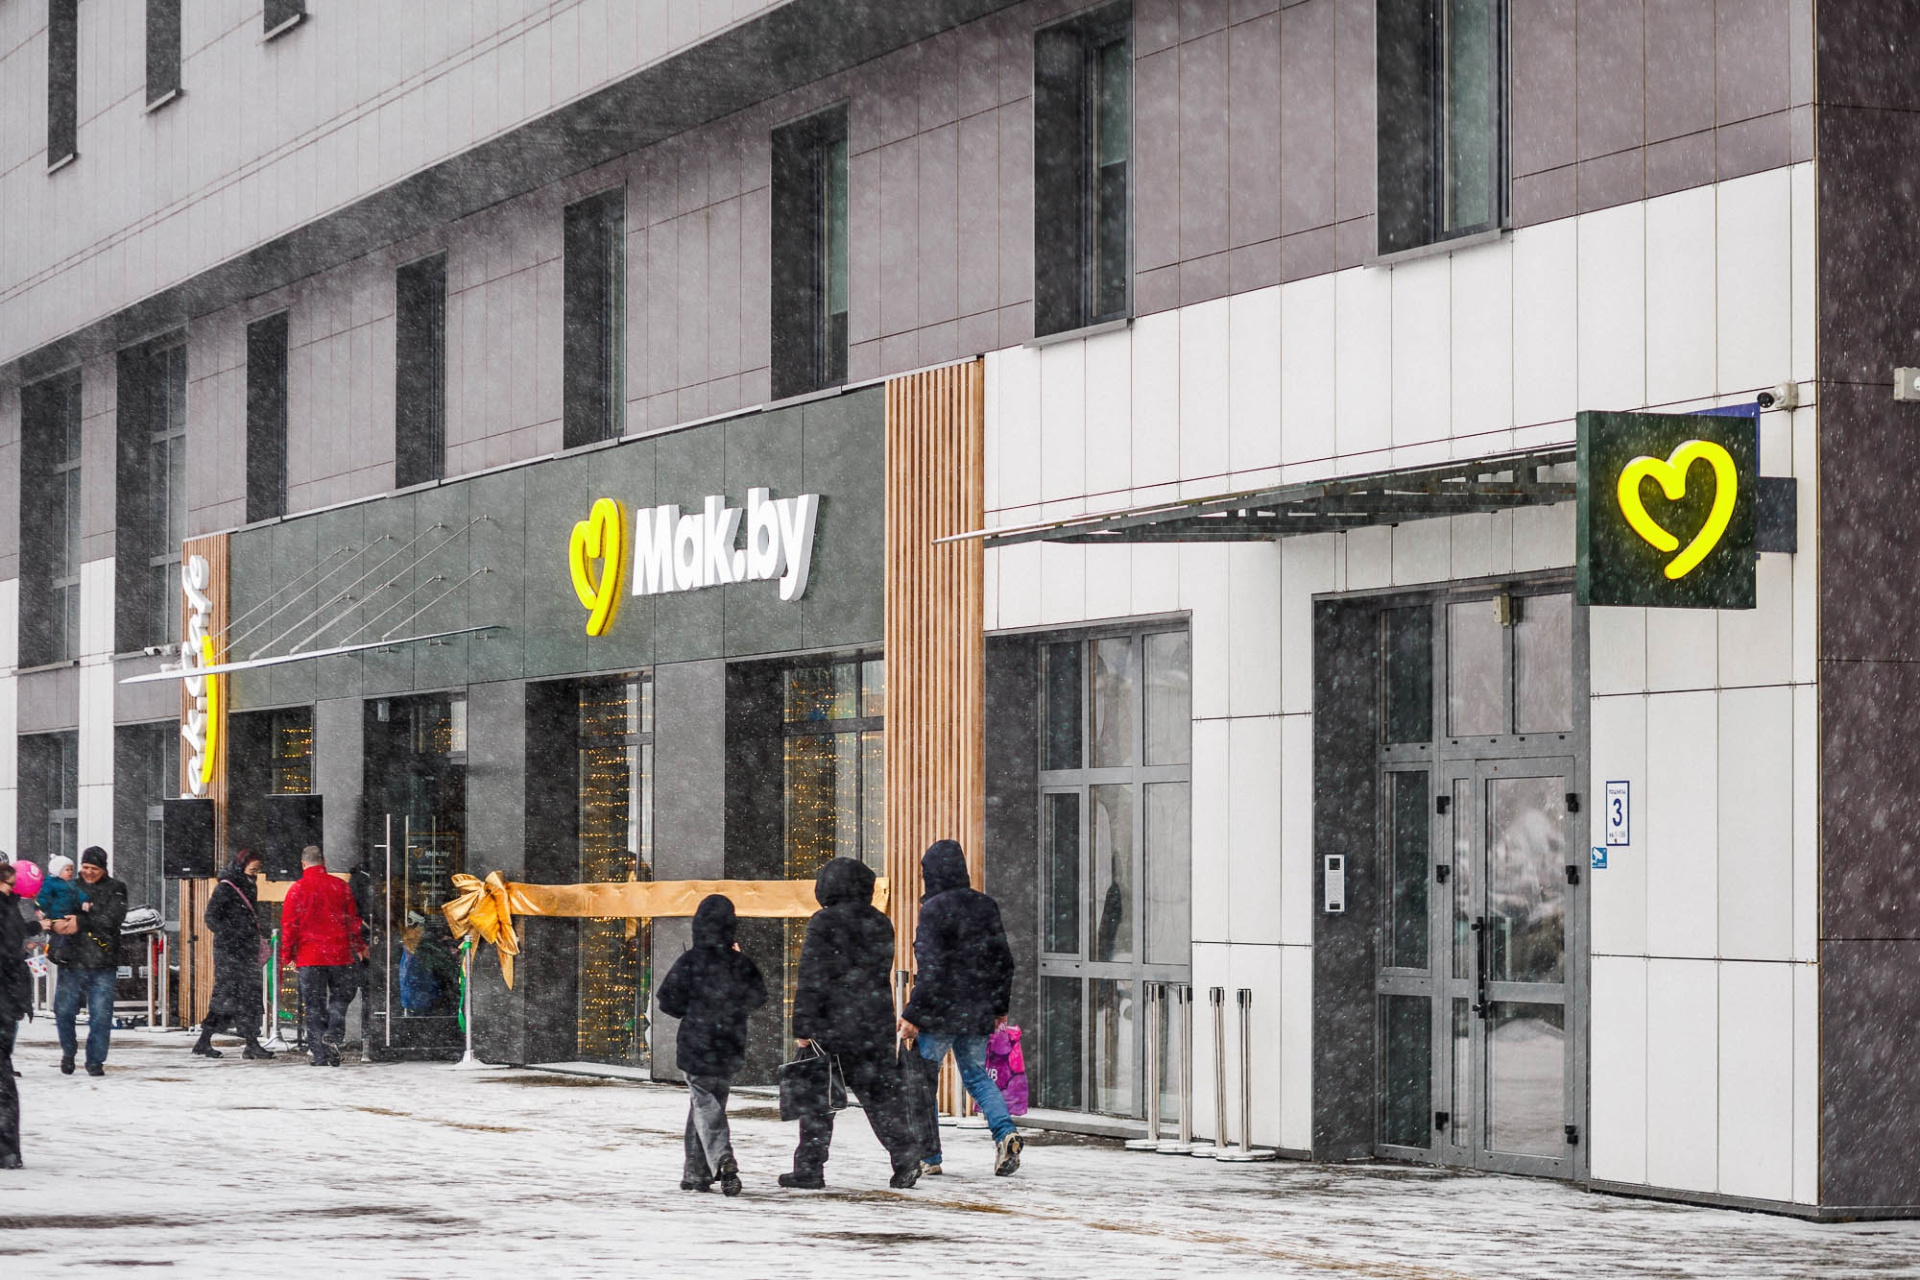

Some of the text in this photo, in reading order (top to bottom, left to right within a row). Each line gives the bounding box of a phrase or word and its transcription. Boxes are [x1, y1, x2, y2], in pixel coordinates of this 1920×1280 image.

[632, 487, 820, 601] Mak.by
[181, 554, 213, 799] ak.Cafe
[1612, 798, 1623, 827] 3
